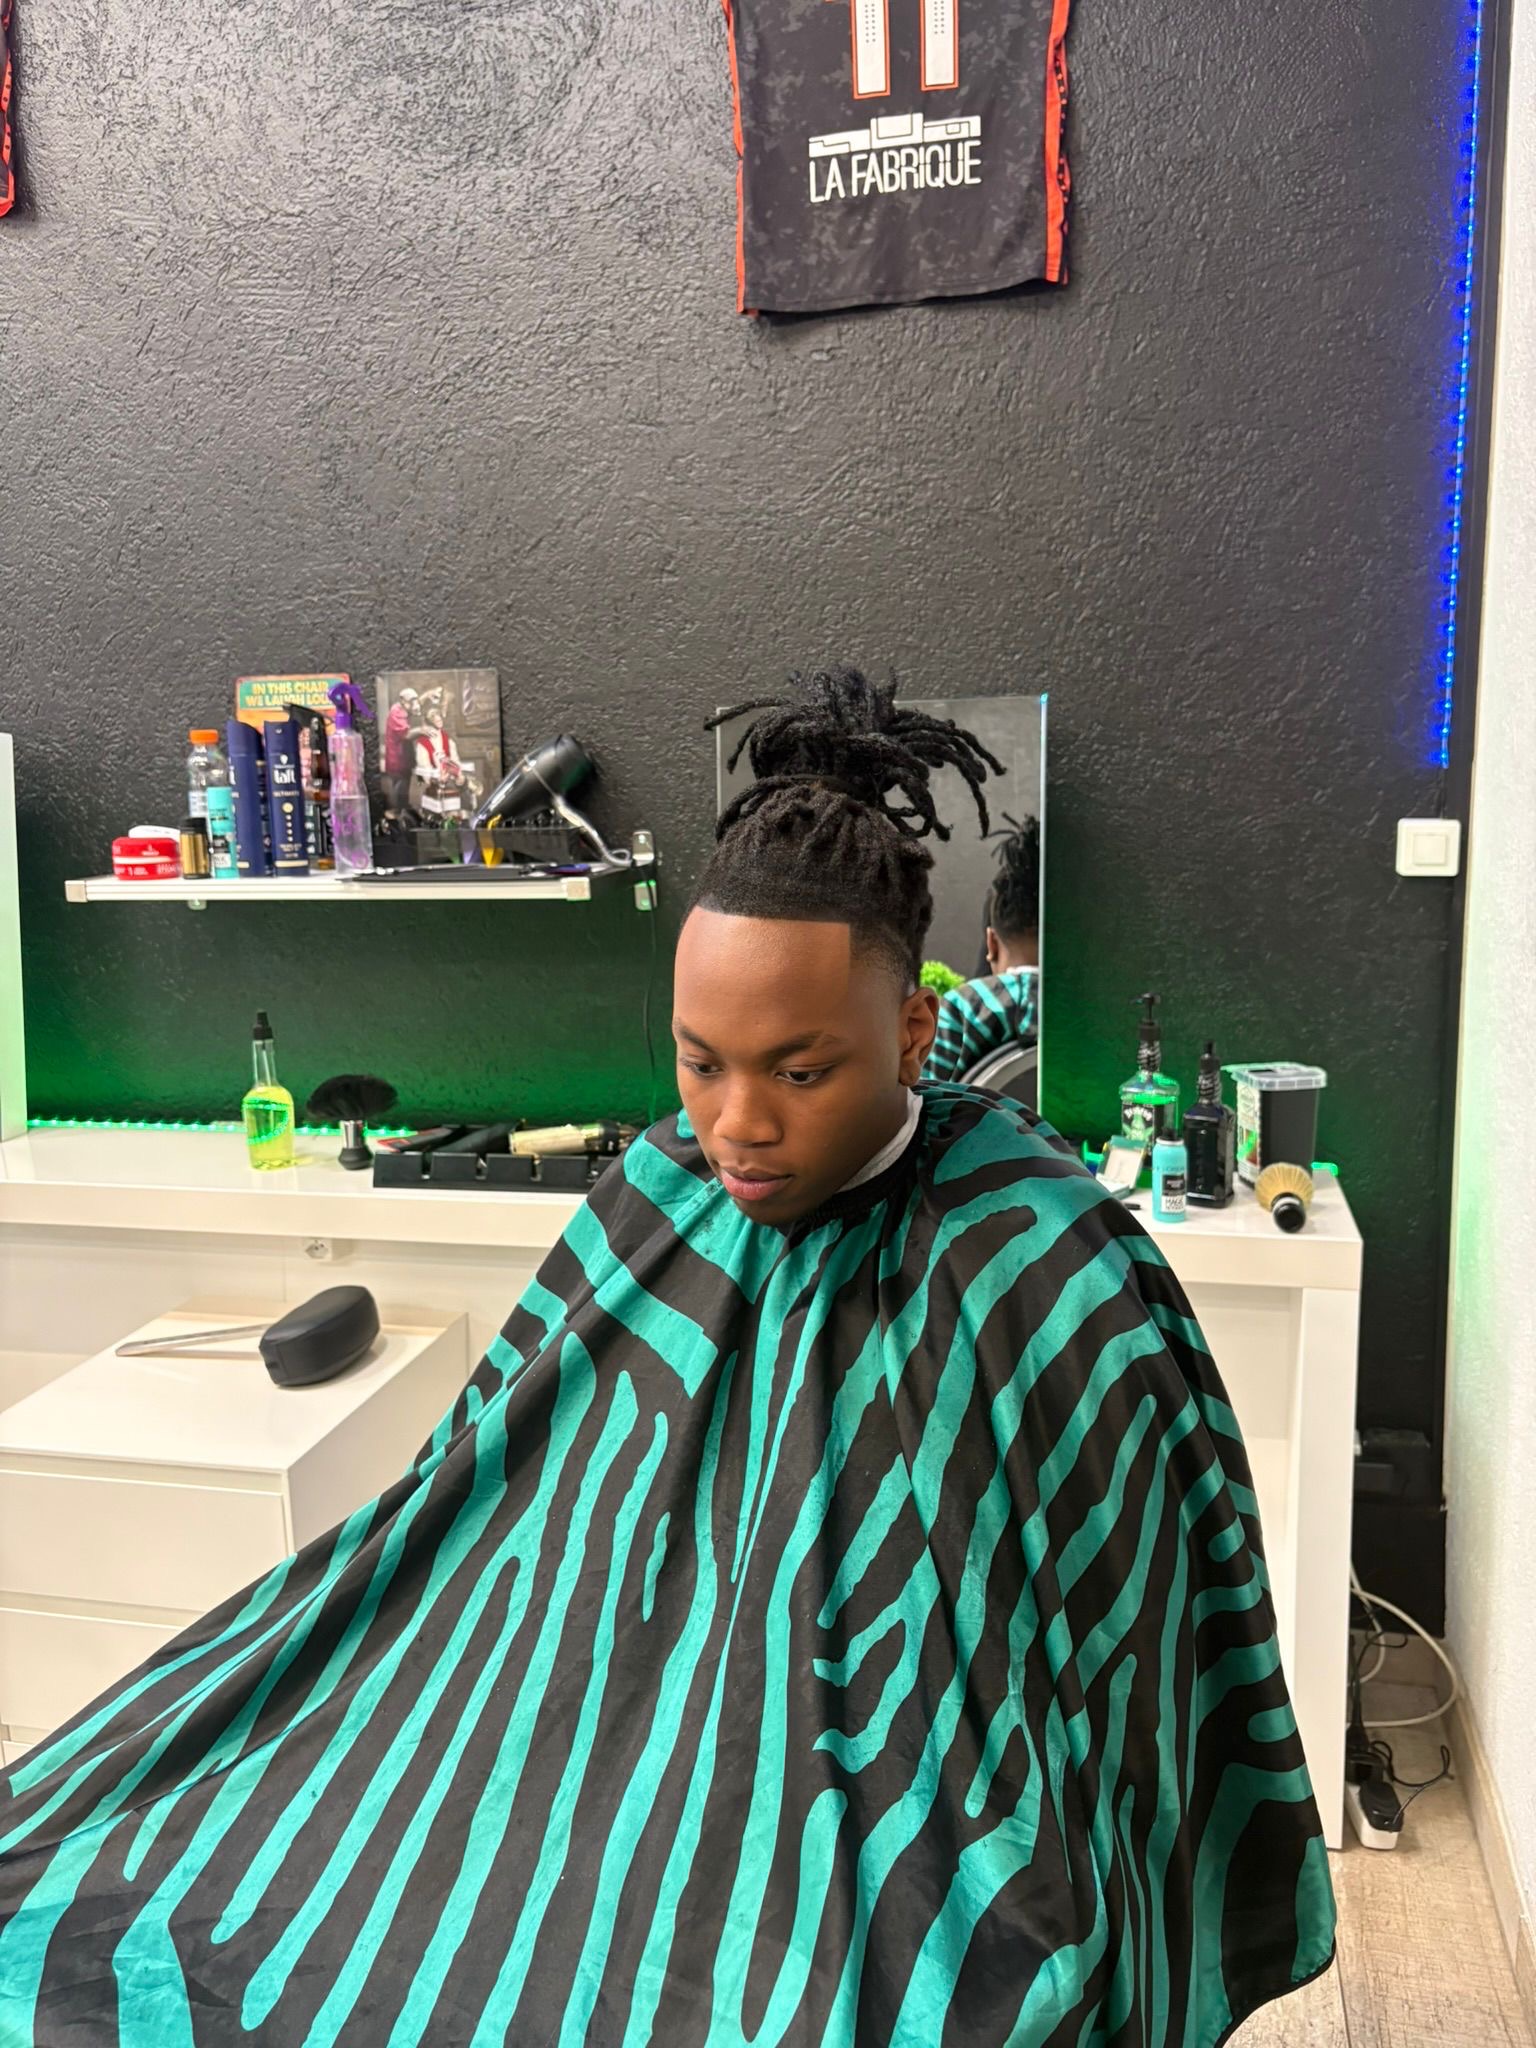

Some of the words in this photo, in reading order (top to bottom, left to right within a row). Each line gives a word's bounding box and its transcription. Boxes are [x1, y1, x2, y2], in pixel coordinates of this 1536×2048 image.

[809, 157, 846, 203] LA
[851, 140, 982, 197] FABRIQUE
[252, 683, 266, 695] IN
[268, 682, 292, 694] THIS
[294, 681, 328, 693] CHAIR
[245, 695, 263, 706] WE
[265, 694, 304, 706] LAUGH
[306, 693, 333, 705] LOU
